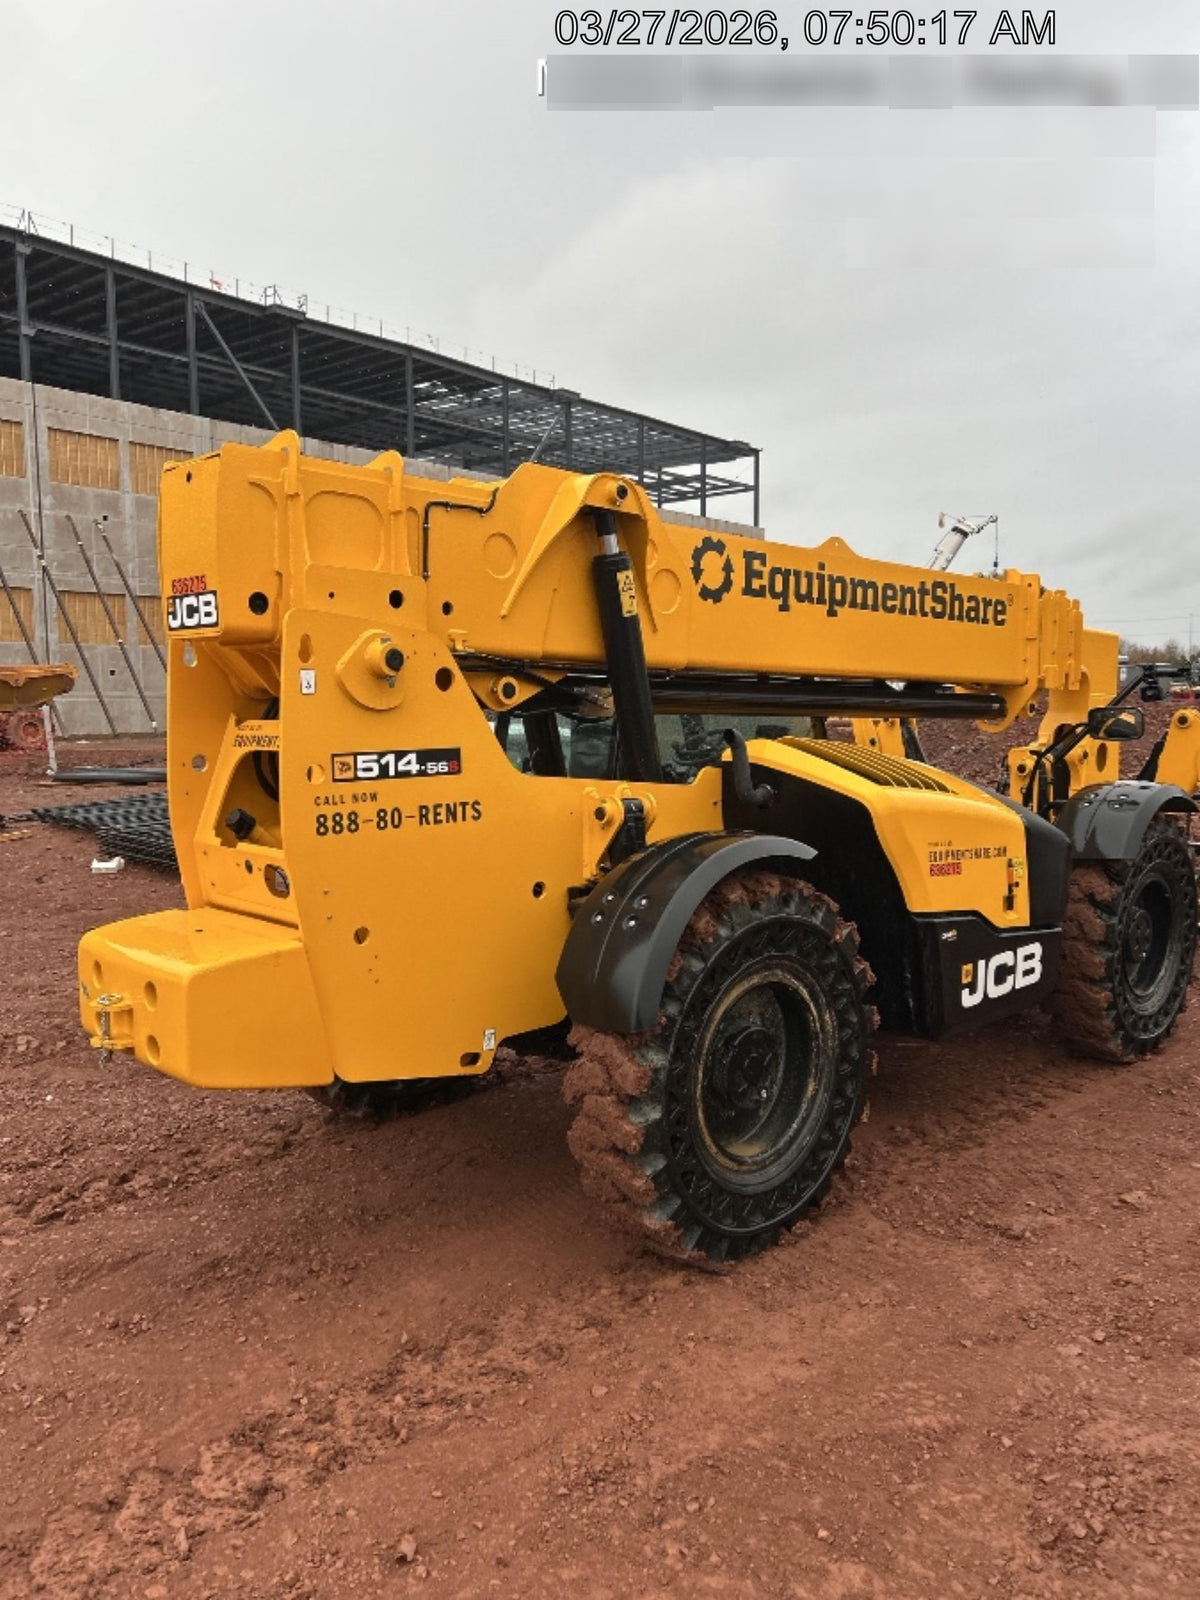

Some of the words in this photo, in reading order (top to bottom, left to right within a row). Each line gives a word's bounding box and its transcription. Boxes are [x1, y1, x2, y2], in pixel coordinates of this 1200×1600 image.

[168, 593, 218, 629] JCB
[314, 794, 346, 807] CALL
[351, 791, 379, 804] NOW
[315, 799, 483, 837] 888-80-RENTS
[960, 941, 1043, 1009] JCB
